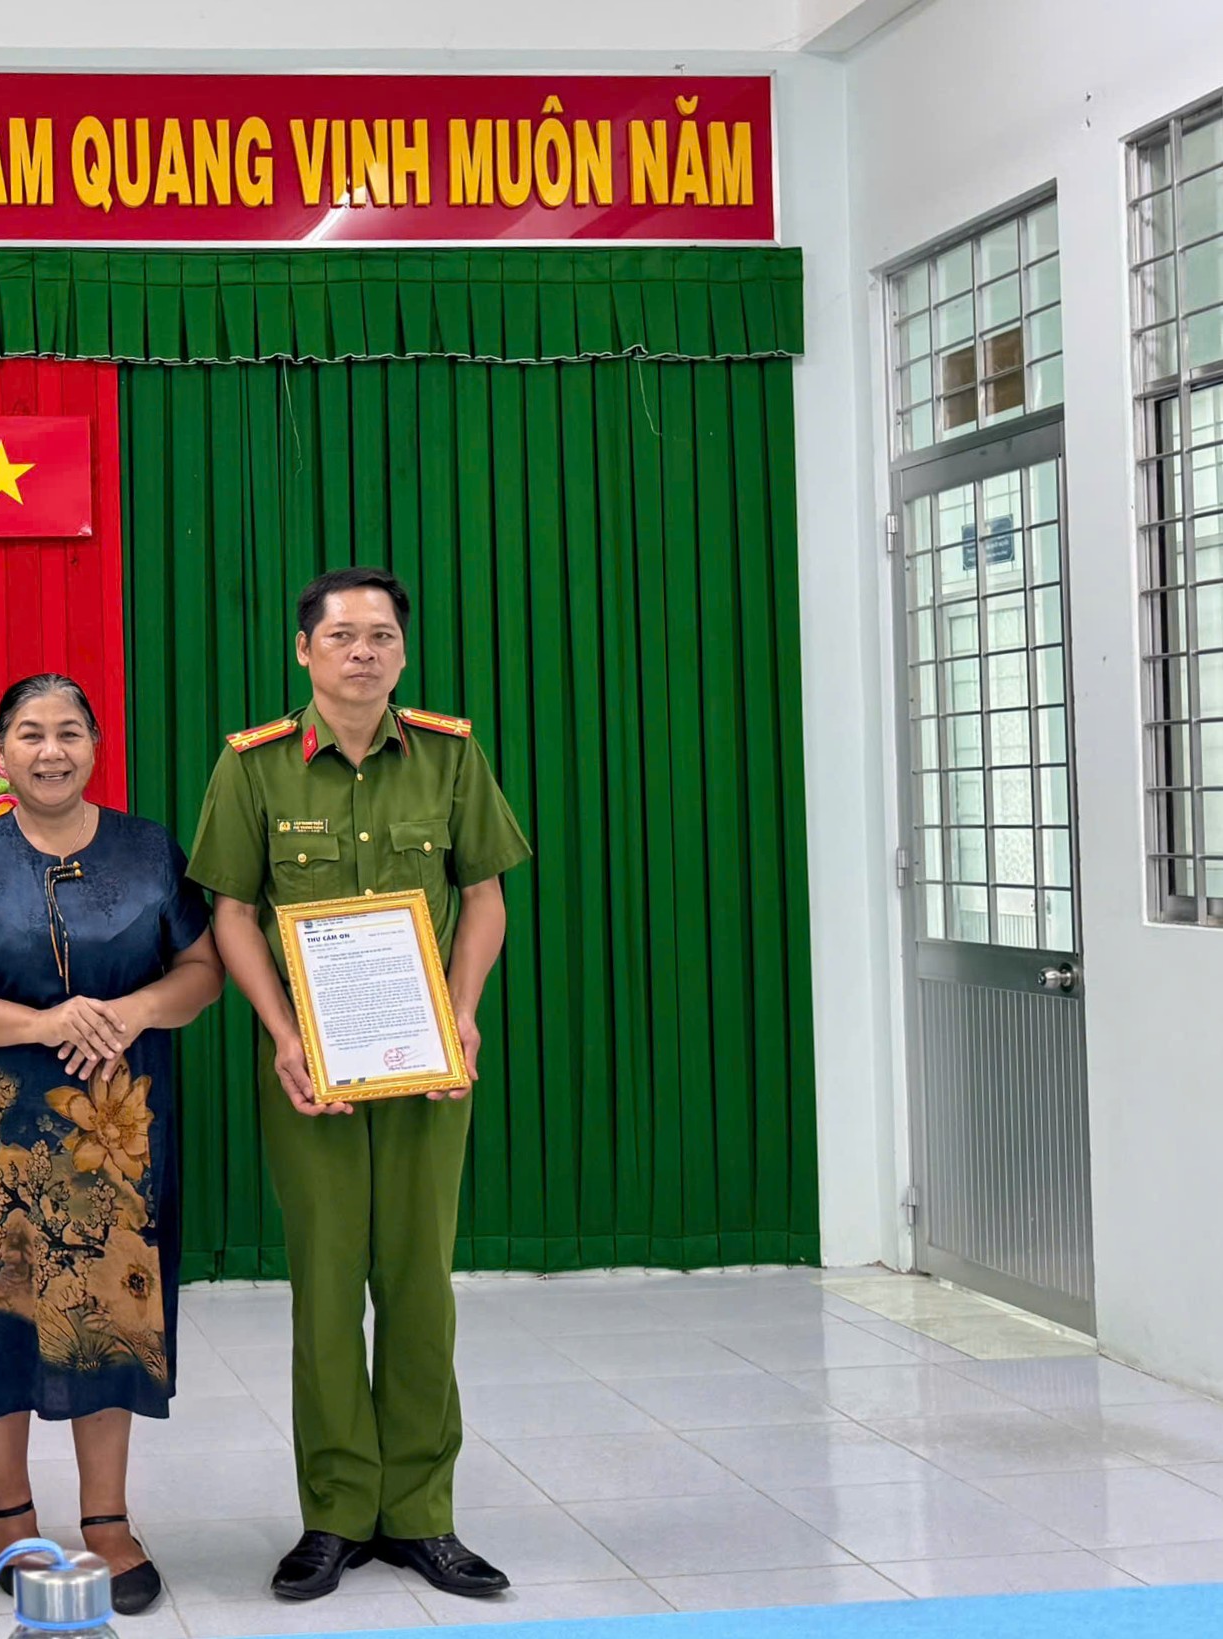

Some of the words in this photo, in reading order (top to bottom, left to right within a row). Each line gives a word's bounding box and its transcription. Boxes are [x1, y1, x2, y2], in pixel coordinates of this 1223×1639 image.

[71, 116, 273, 212] QUANG
[291, 118, 431, 206] VINH
[449, 96, 613, 207] MUÔN
[630, 96, 753, 206] NĂM
